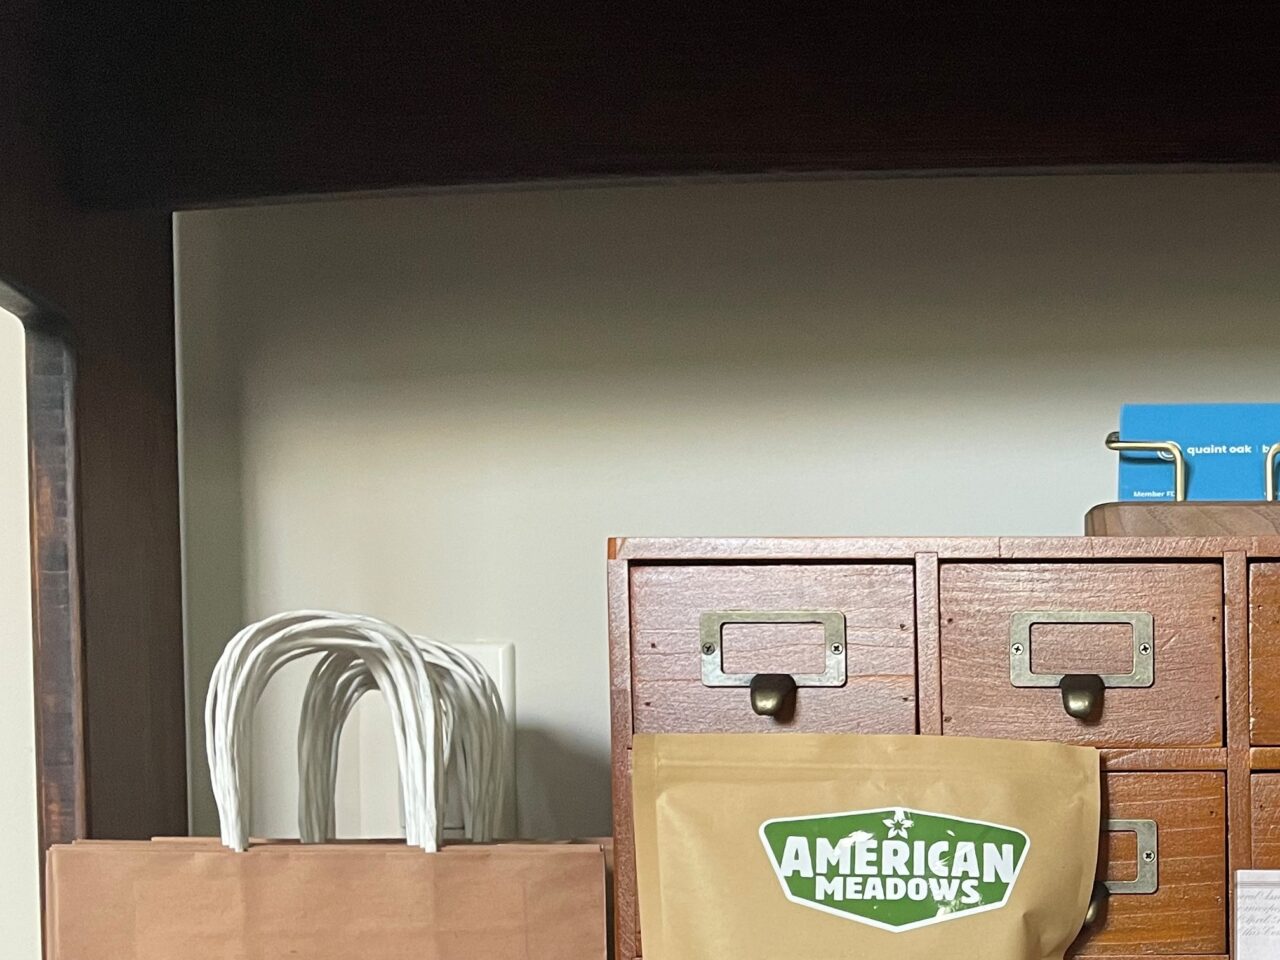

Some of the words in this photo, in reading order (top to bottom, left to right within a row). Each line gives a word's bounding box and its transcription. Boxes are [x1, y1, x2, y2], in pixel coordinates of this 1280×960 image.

[1187, 444, 1227, 455] quaint
[1229, 445, 1252, 454] oak
[780, 835, 1014, 884] AMERICAN
[815, 875, 982, 905] MEADOWS
